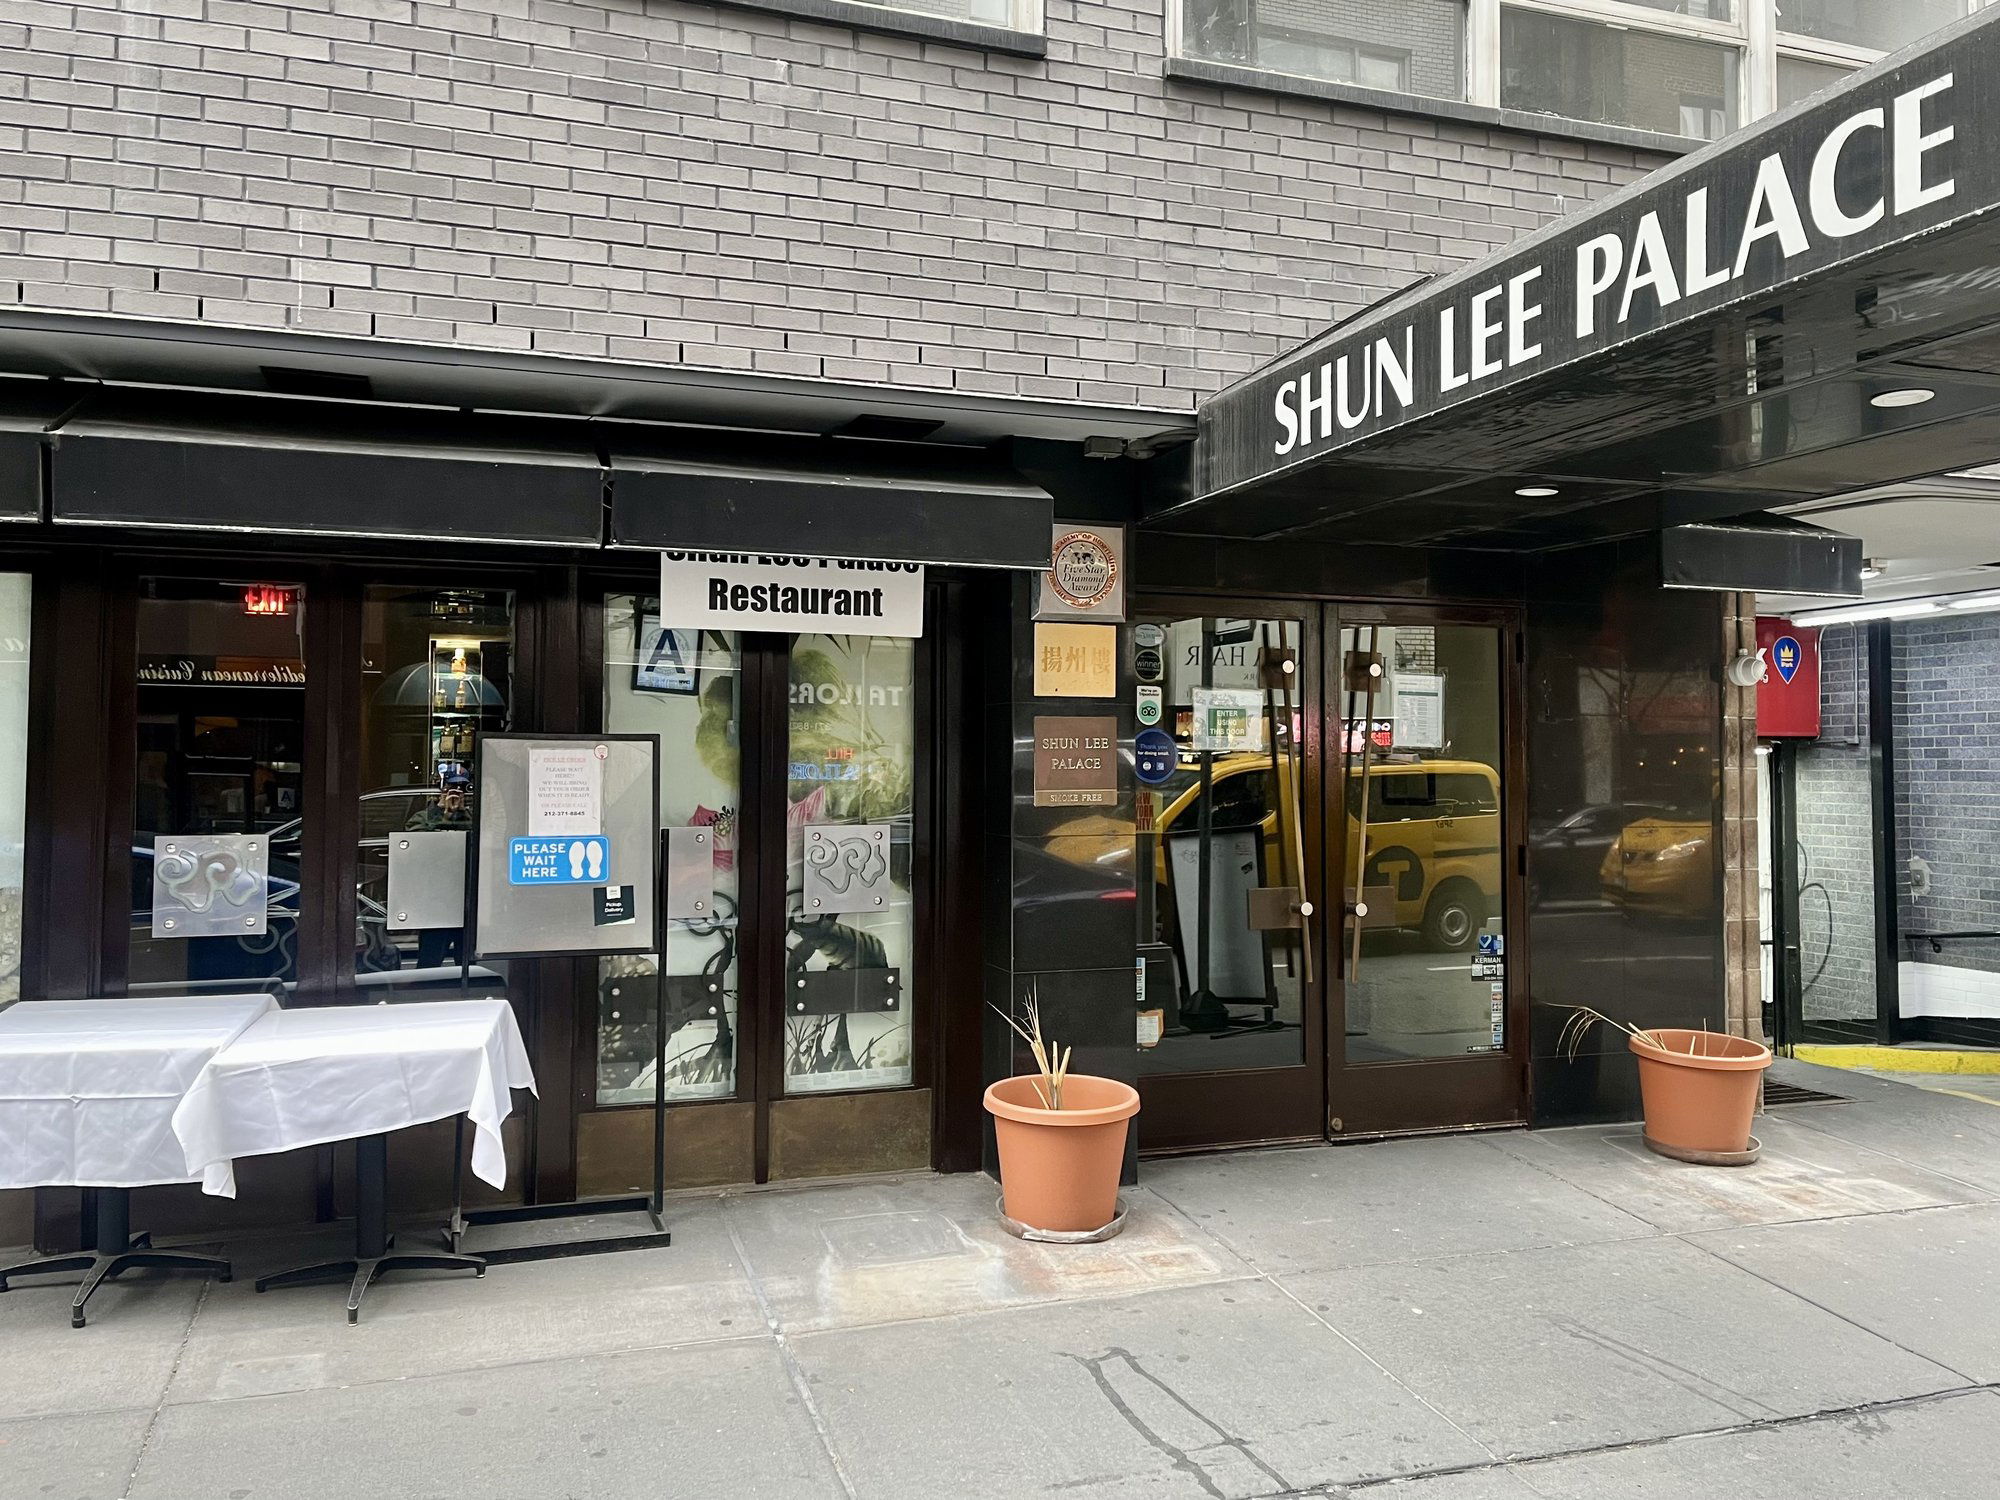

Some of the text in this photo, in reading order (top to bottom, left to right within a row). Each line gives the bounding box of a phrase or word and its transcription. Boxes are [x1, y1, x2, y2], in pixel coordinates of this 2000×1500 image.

[1274, 72, 1957, 455] SHUN LEE PALACE
[1063, 564, 1105, 574] Five Star
[1063, 573, 1105, 583] Diamond
[1068, 583, 1100, 591] Award
[709, 577, 883, 617] Restaurant
[645, 629, 686, 674] A
[1137, 660, 1161, 668] winner
[1209, 728, 1245, 736] THIS DOOR
[1042, 738, 1109, 750] SHUN LEE
[1051, 758, 1102, 770] PALACE
[1050, 793, 1102, 802] SMOKE FREE
[514, 843, 566, 854] PLEASE
[524, 855, 556, 866] WAIT
[522, 867, 558, 878] HERE
